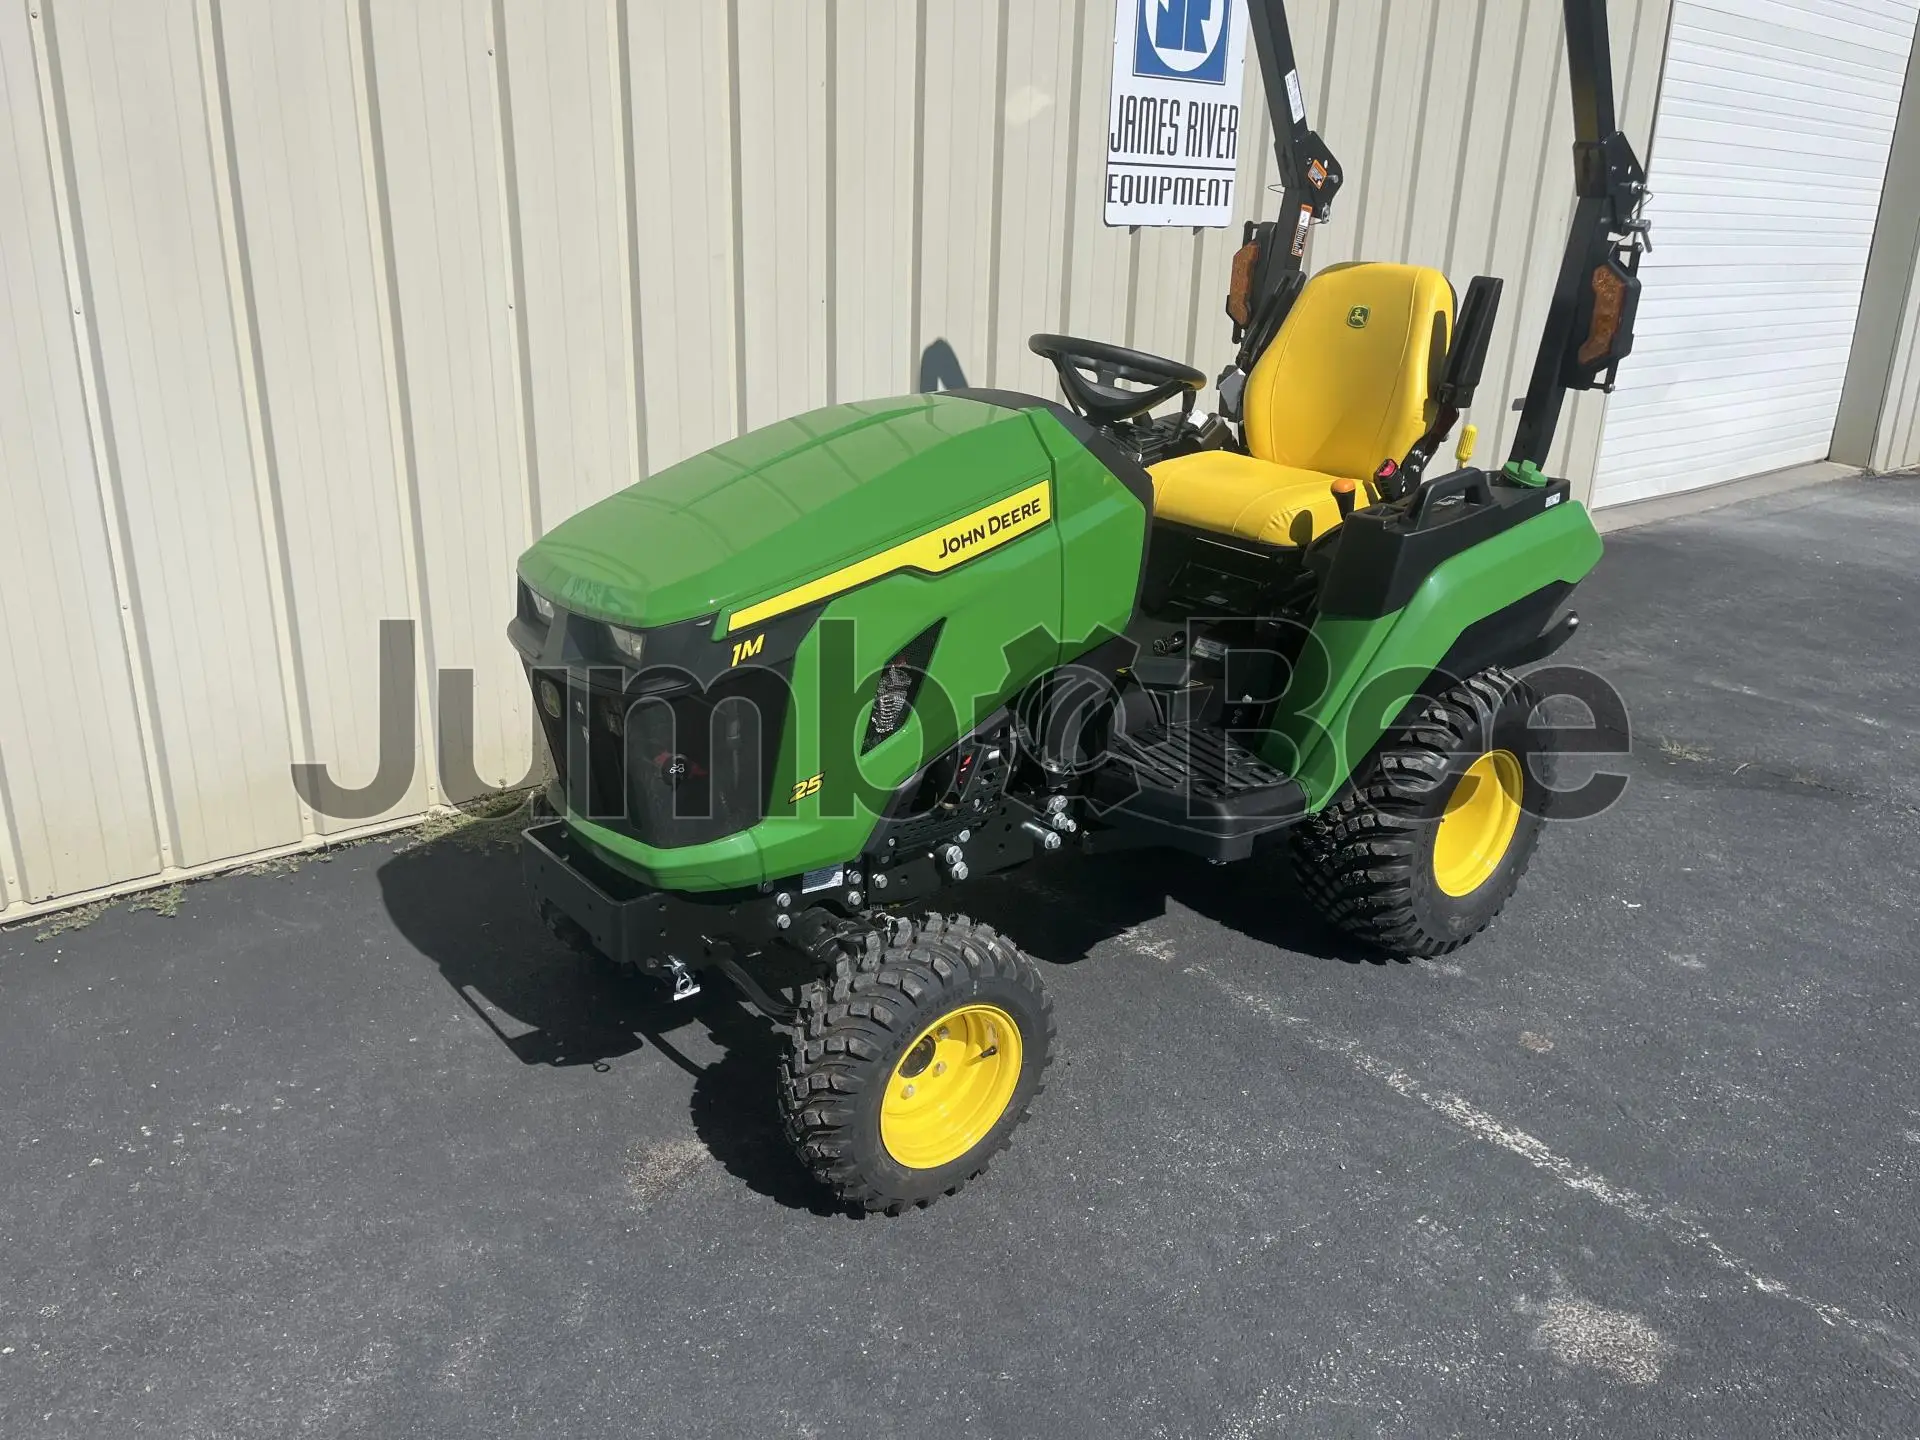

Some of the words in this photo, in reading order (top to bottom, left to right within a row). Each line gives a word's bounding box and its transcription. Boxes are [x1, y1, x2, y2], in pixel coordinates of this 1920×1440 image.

[1111, 95, 1181, 157] JAMES
[1185, 101, 1238, 160] RIVER
[1107, 174, 1233, 207] EQUIPMENT
[939, 524, 985, 559] JOHN
[988, 498, 1041, 536] DEERE
[731, 634, 765, 667] 1M
[789, 772, 825, 803] 25
